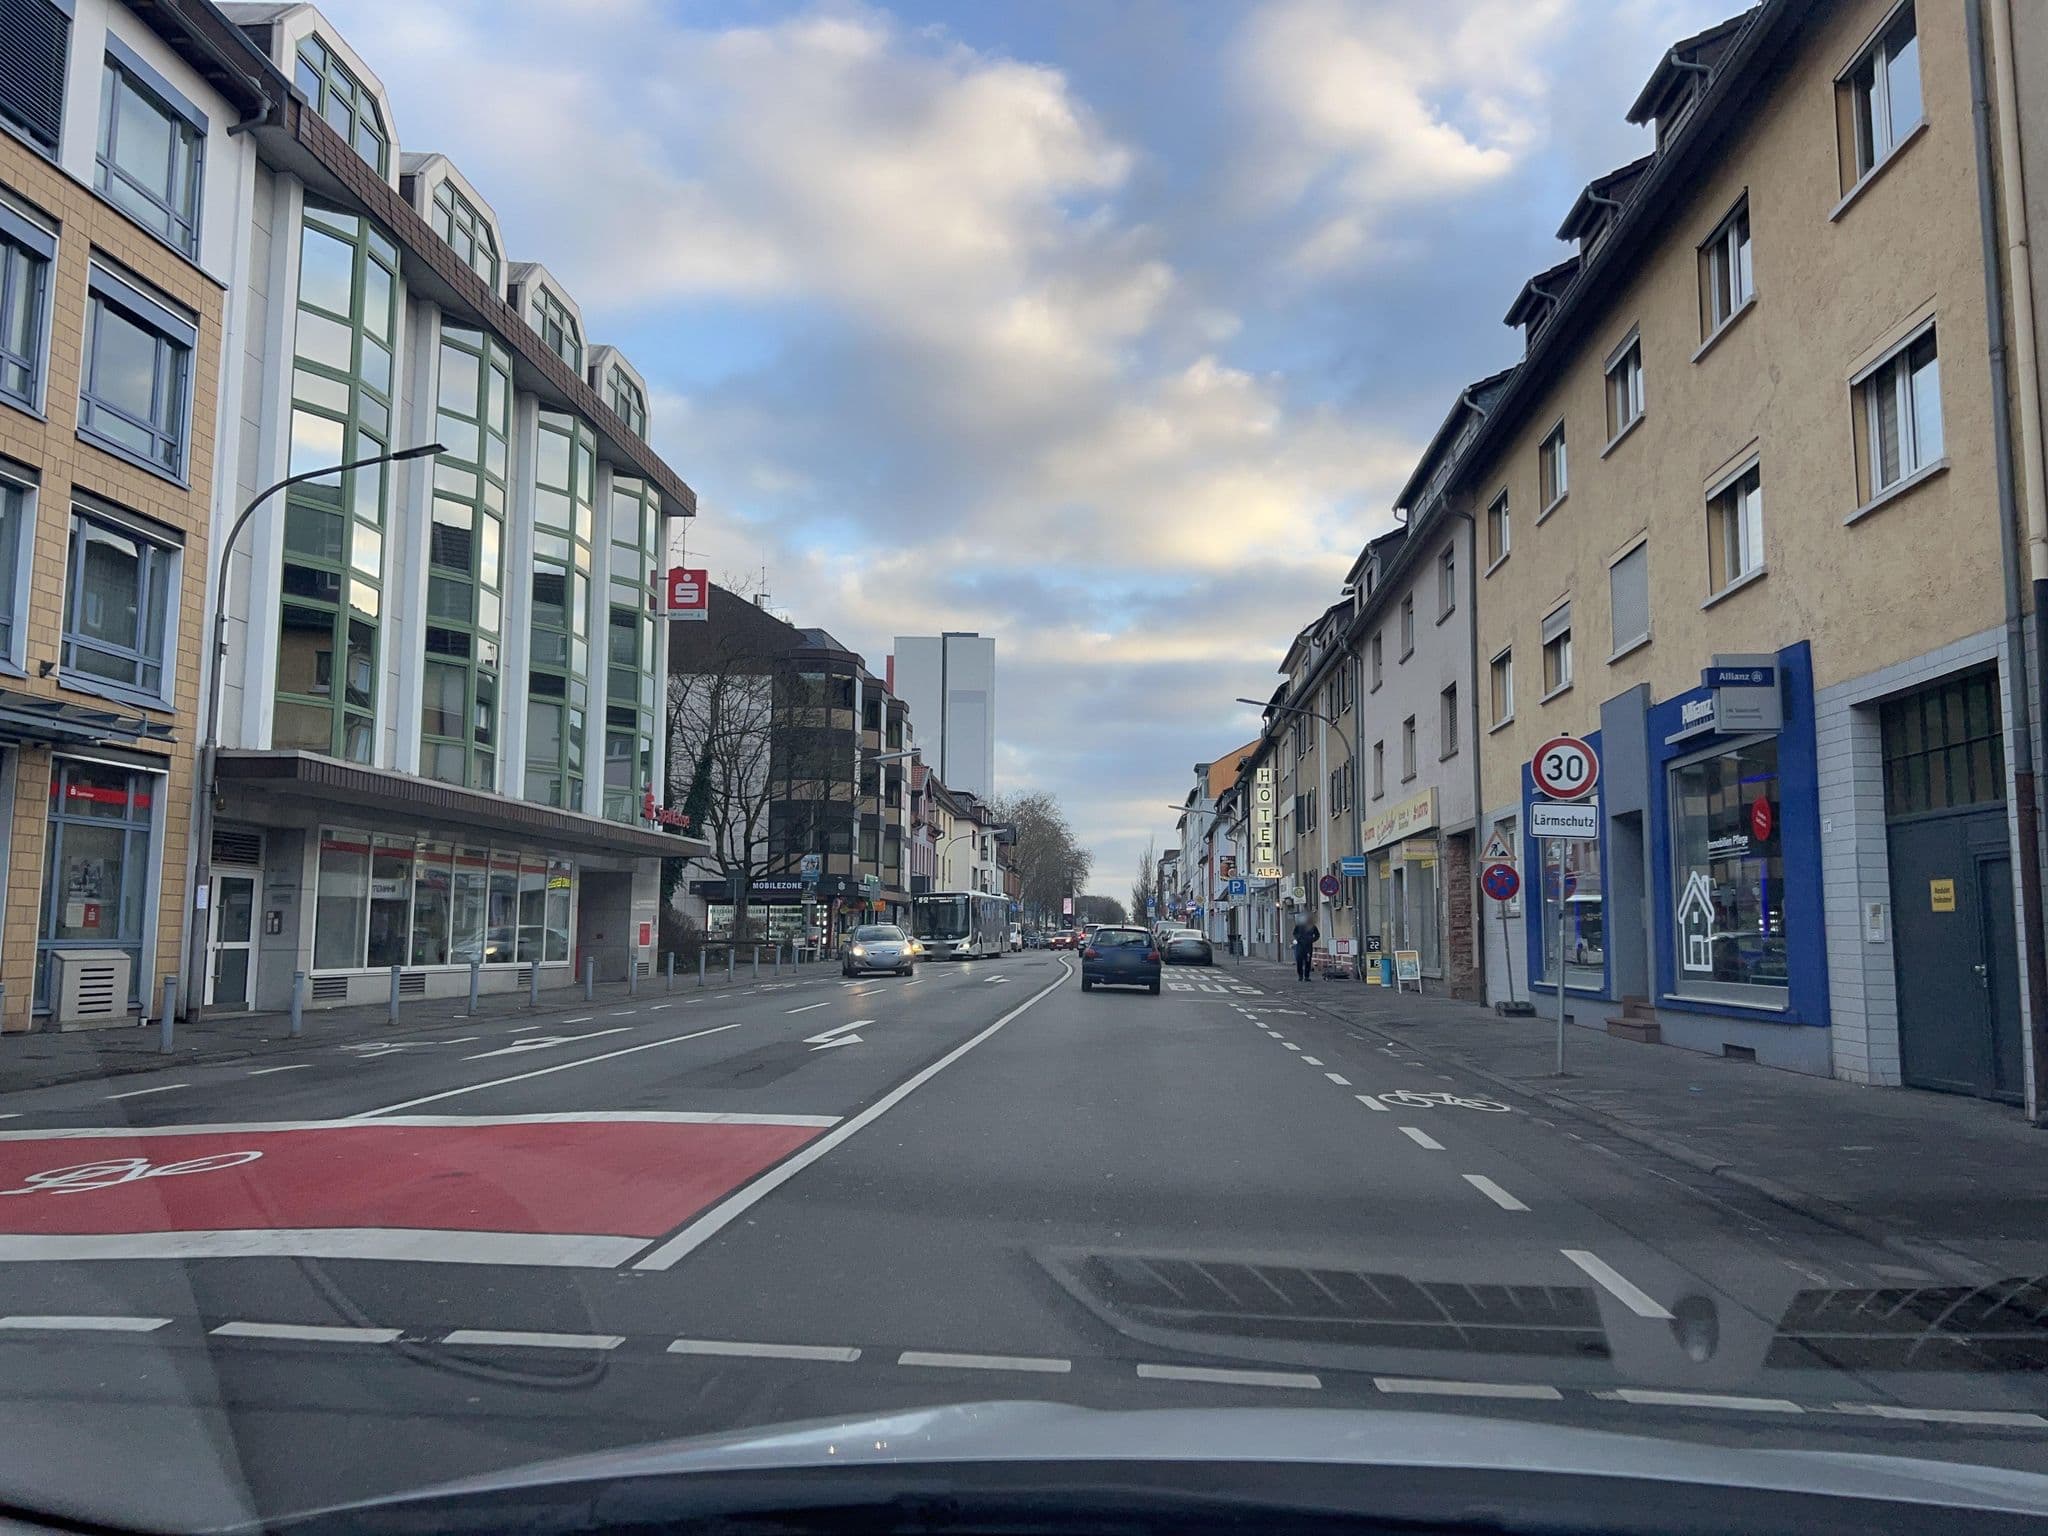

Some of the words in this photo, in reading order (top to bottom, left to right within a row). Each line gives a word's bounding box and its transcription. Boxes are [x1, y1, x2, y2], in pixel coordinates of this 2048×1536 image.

[1719, 672, 1750, 681] Allianz
[1546, 754, 1583, 781] 30
[1260, 769, 1271, 861] HOTEL
[1534, 814, 1594, 828] Lärmschutz
[1256, 868, 1281, 877] ALFA
[752, 881, 803, 889] MOBILEZONE
[1167, 982, 1265, 996] BUS
